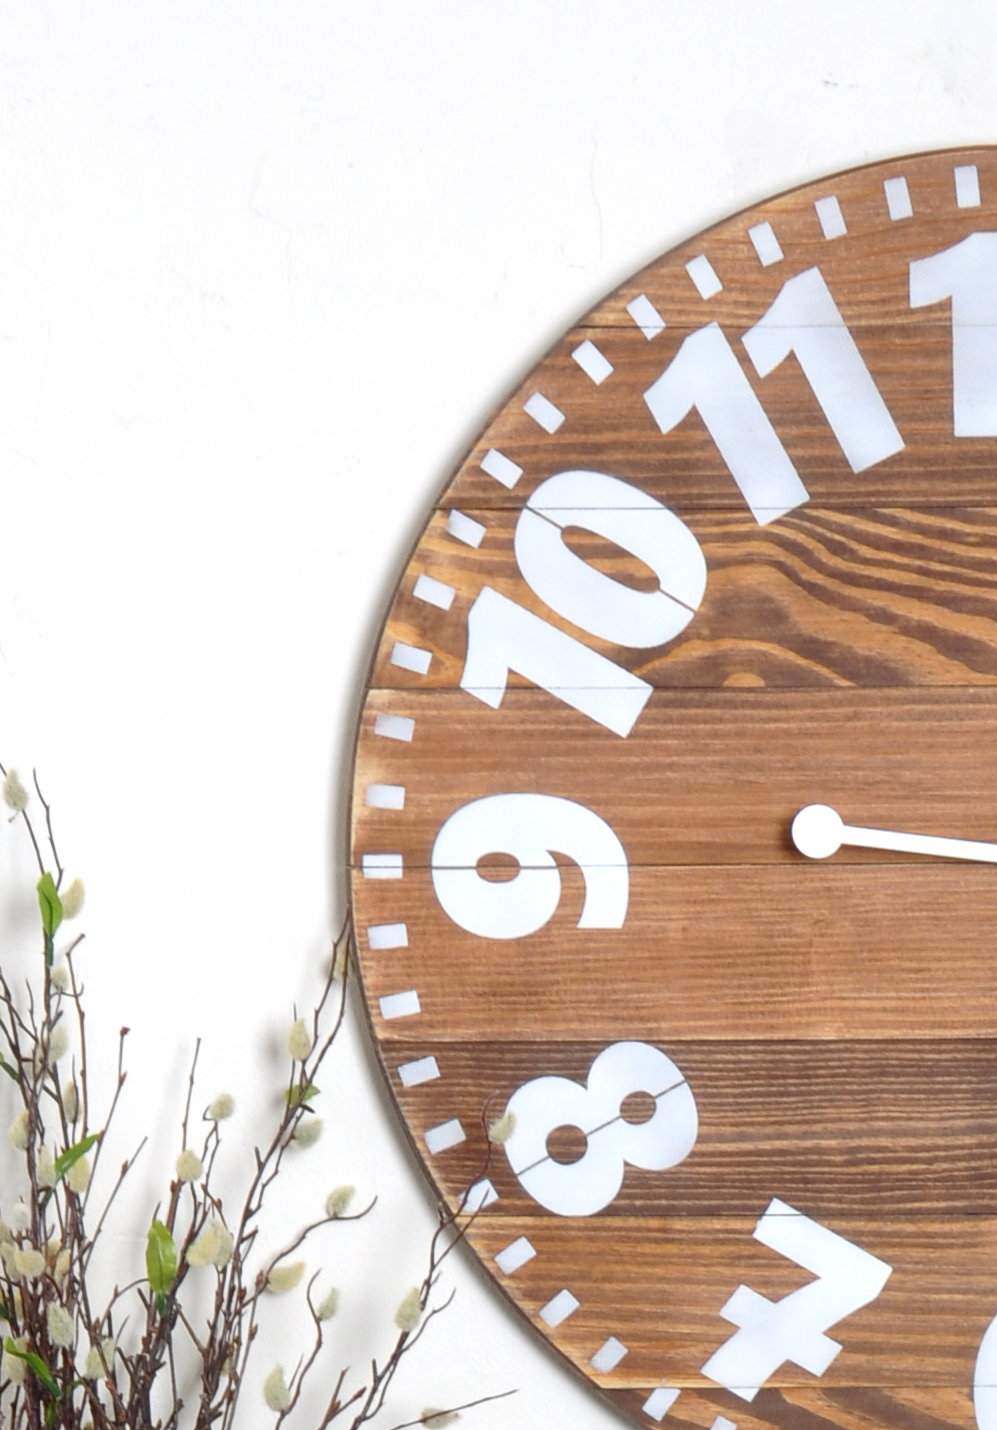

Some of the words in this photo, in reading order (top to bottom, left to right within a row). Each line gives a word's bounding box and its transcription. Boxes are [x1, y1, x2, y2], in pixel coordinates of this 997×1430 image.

[642, 265, 907, 527] 11
[459, 470, 708, 739] 10
[430, 791, 632, 940] 9
[503, 1040, 701, 1218] 8
[699, 1198, 894, 1403] 7
